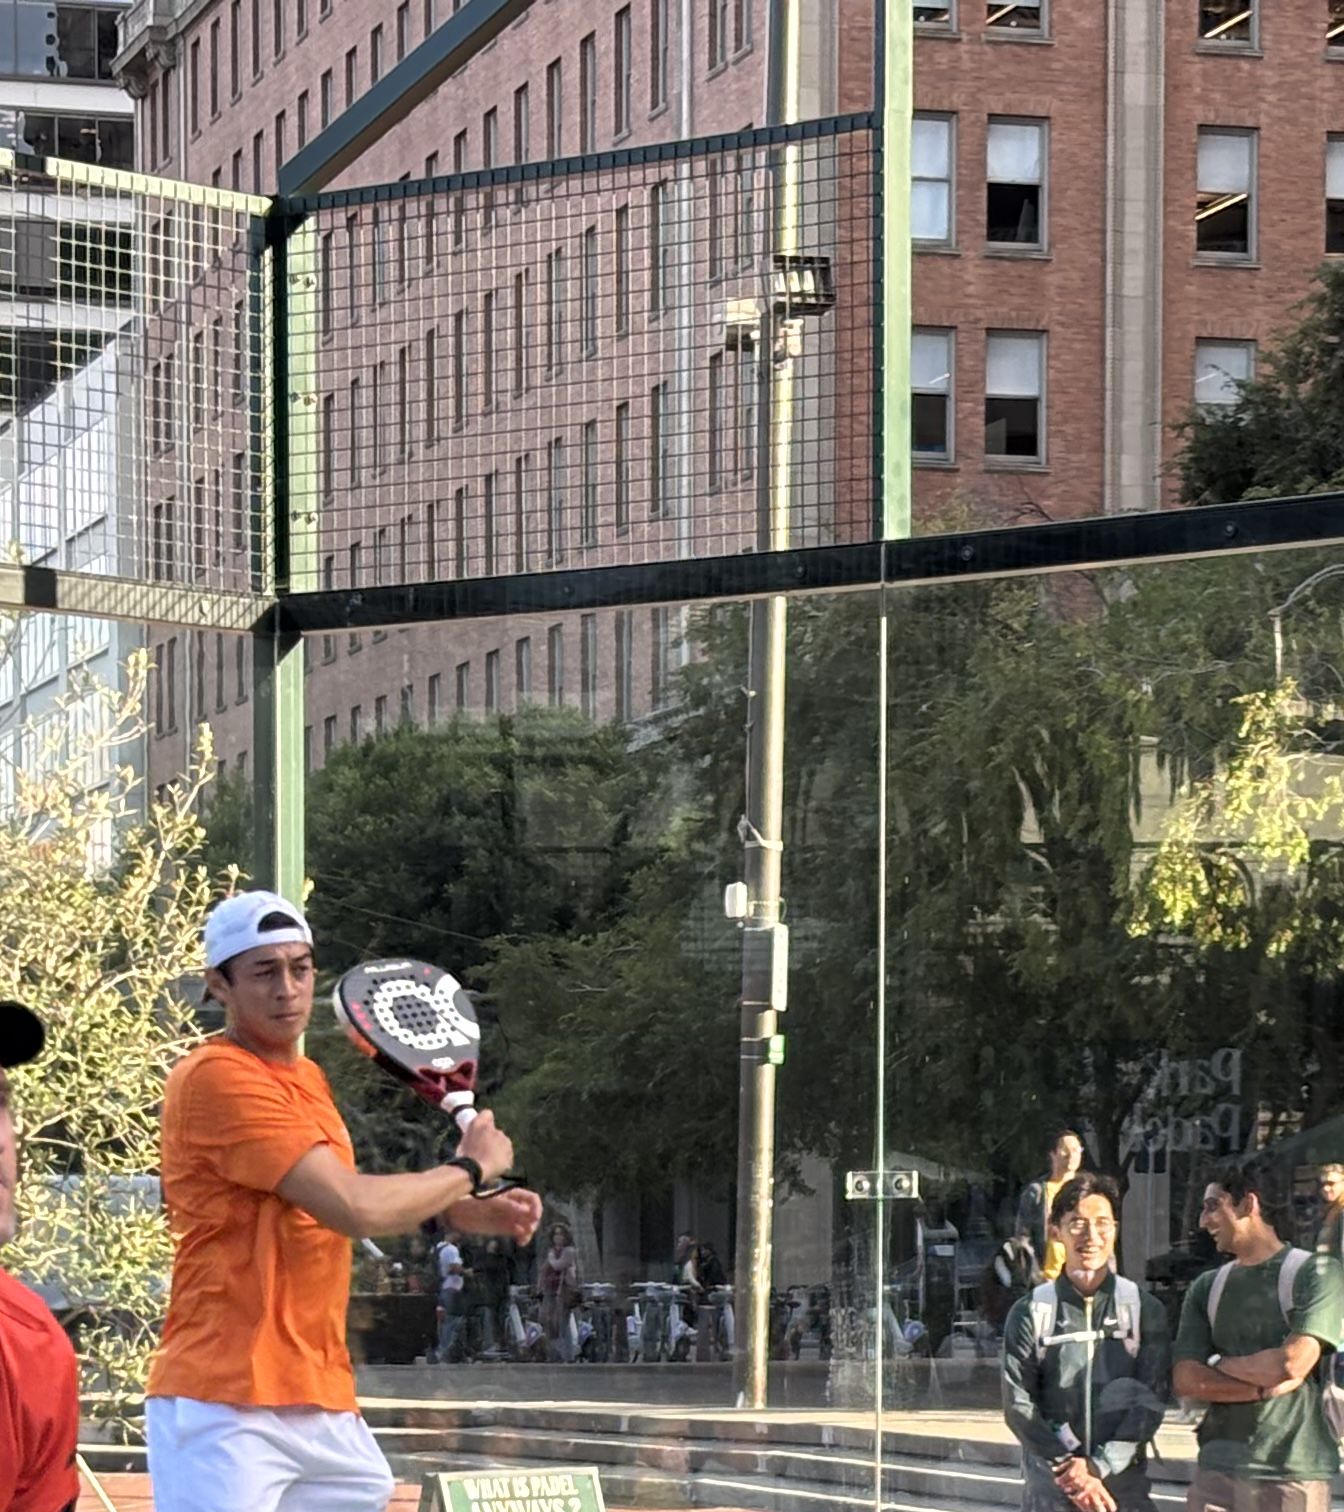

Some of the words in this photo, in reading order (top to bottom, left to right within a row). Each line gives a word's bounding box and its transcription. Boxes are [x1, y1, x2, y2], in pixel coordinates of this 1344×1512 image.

[463, 1477, 511, 1500] WHAT
[512, 1476, 530, 1498] IS
[530, 1474, 579, 1498] PADEL
